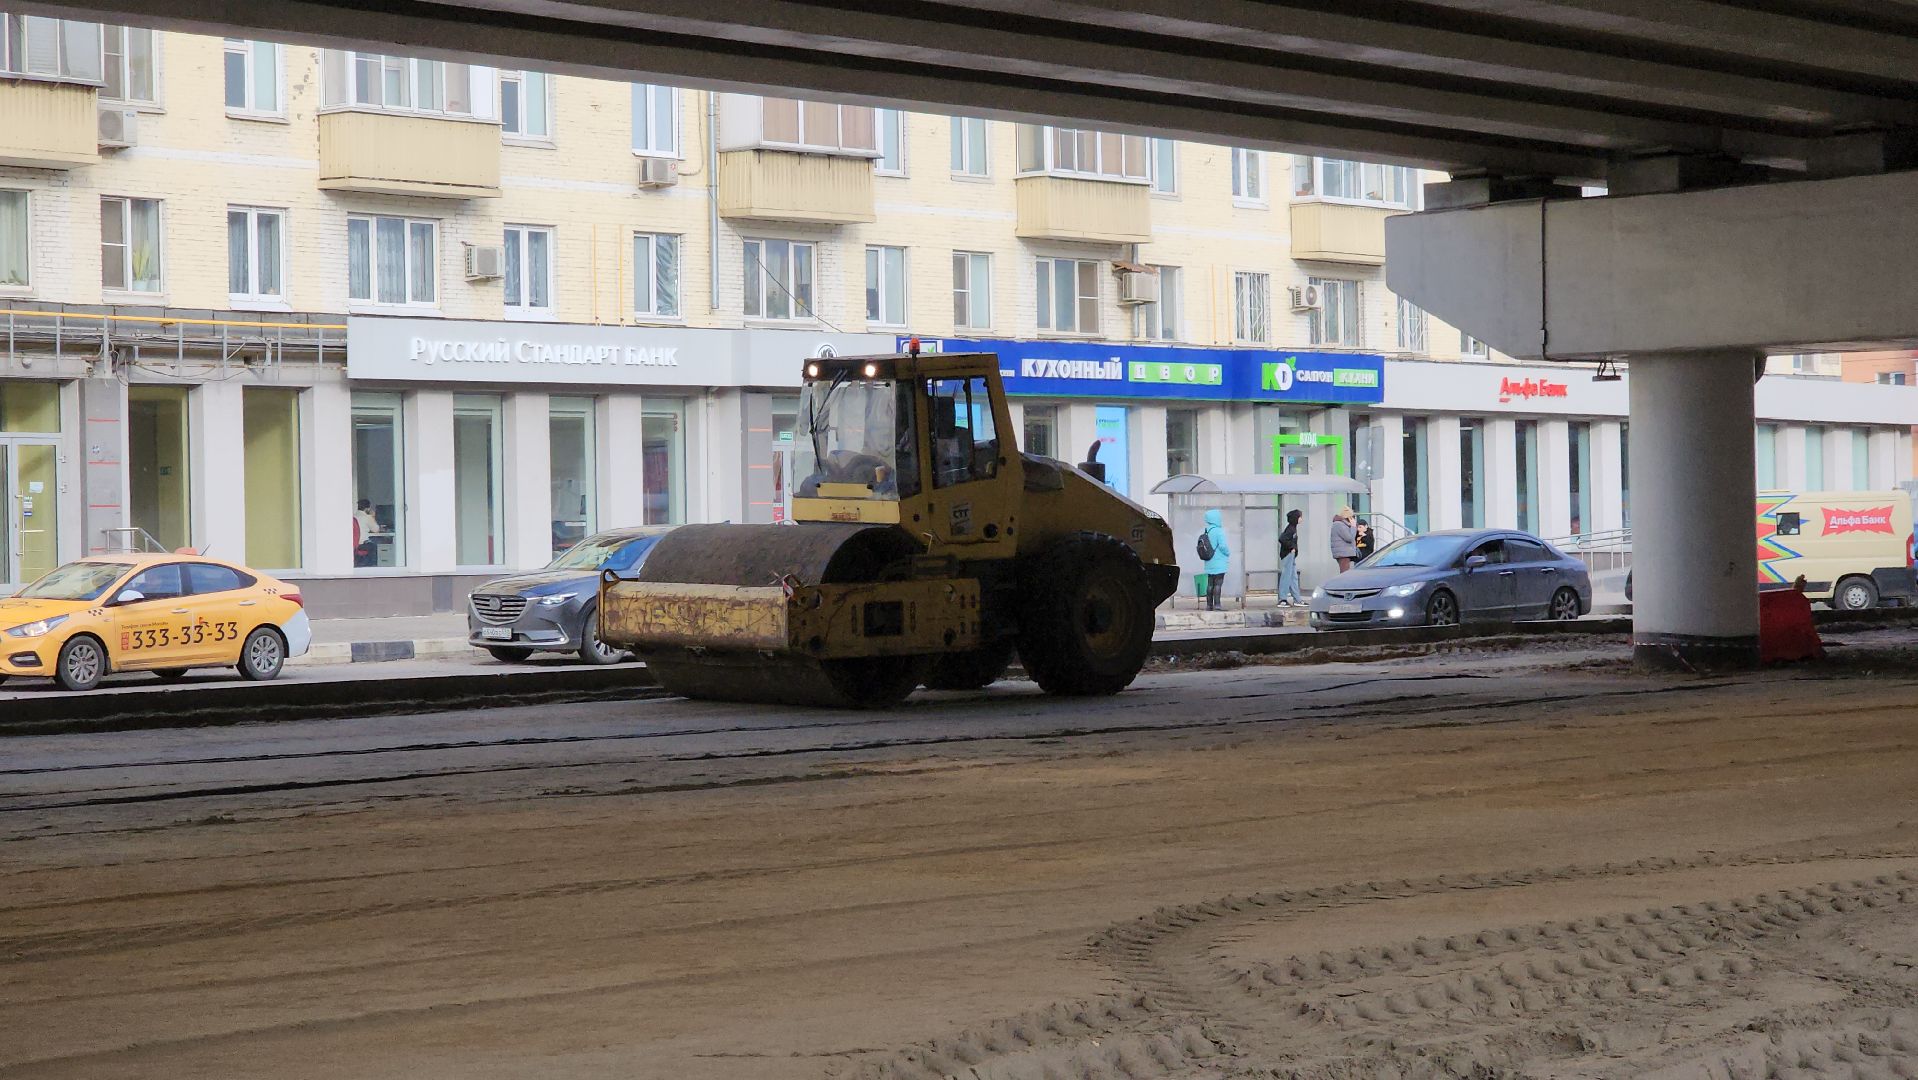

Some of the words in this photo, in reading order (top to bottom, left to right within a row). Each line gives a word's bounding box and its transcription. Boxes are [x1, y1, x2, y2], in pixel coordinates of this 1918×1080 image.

[410, 337, 511, 365] РУССКИЙ
[516, 340, 621, 365] СТАНДАРТ
[624, 346, 679, 367] БАНК
[1021, 356, 1123, 381] КУХОННЫЙ
[1539, 379, 1568, 397] Банк
[1829, 515, 1861, 528] Альфа
[1862, 515, 1887, 525] Банк
[132, 621, 239, 650] 333-33-33
